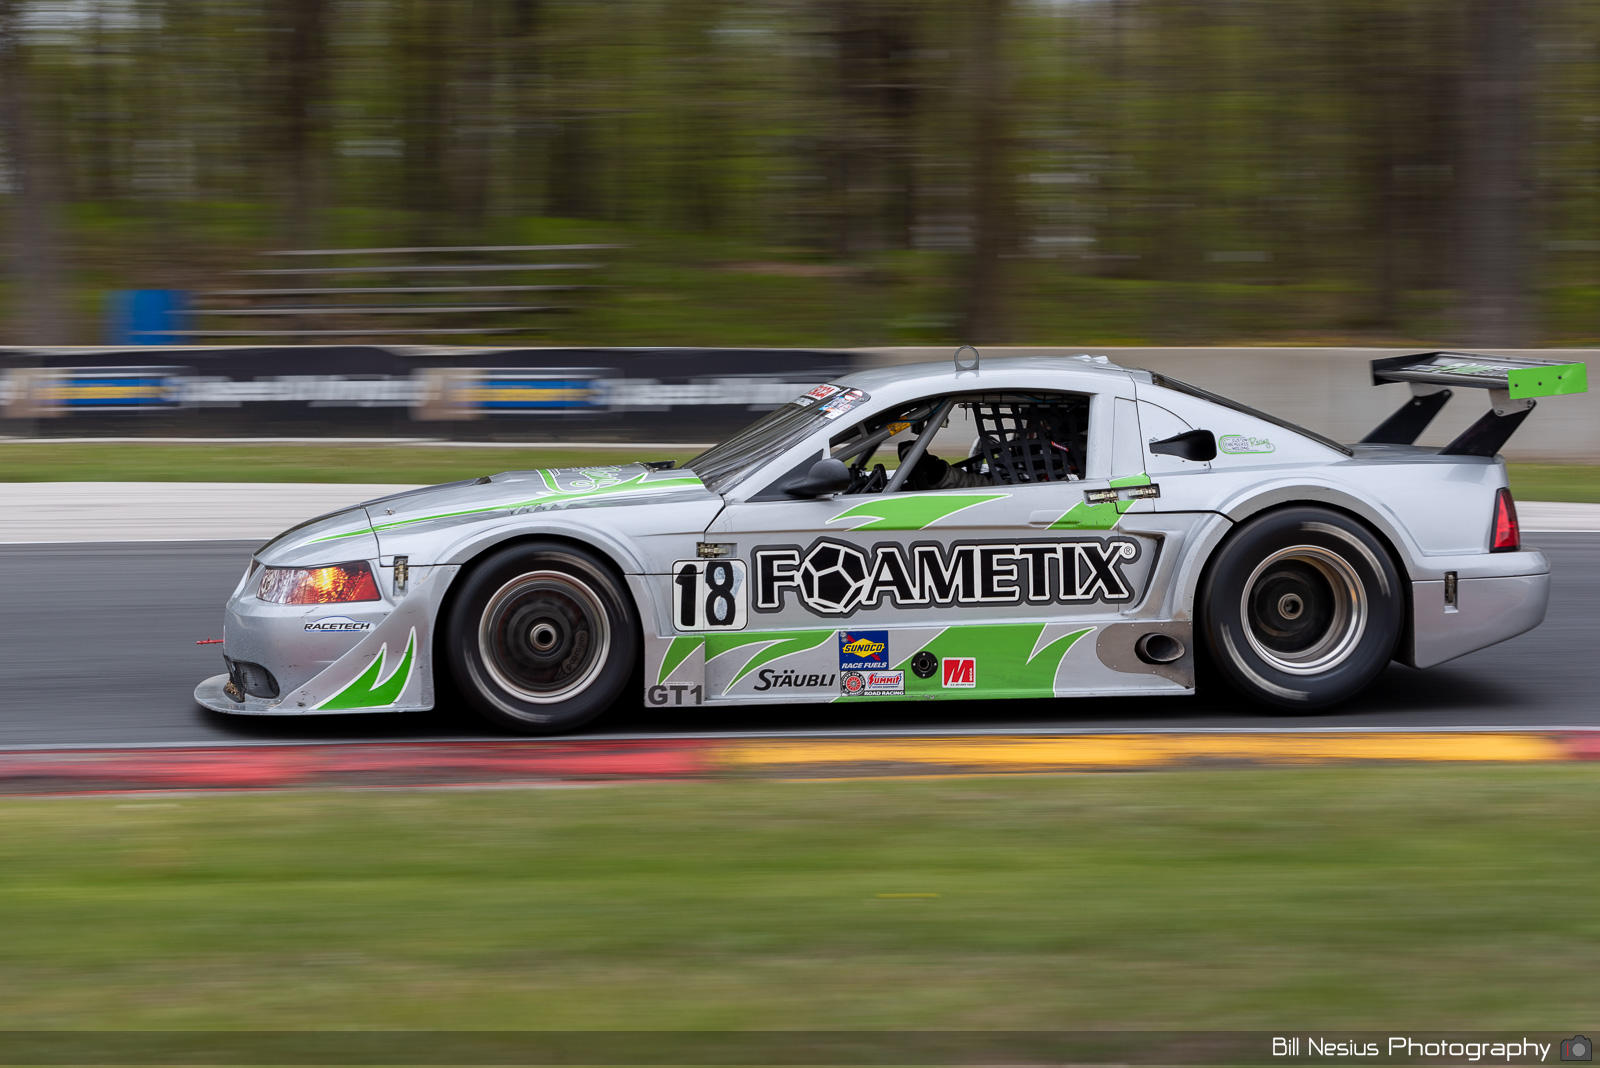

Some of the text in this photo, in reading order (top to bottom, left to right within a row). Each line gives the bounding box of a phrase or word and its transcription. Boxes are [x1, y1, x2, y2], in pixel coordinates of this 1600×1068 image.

[675, 560, 736, 627] 18
[844, 644, 883, 652] SUNOCO
[863, 661, 888, 669] FUELS
[753, 669, 836, 691] STÄUBLI
[648, 684, 703, 706] GT1
